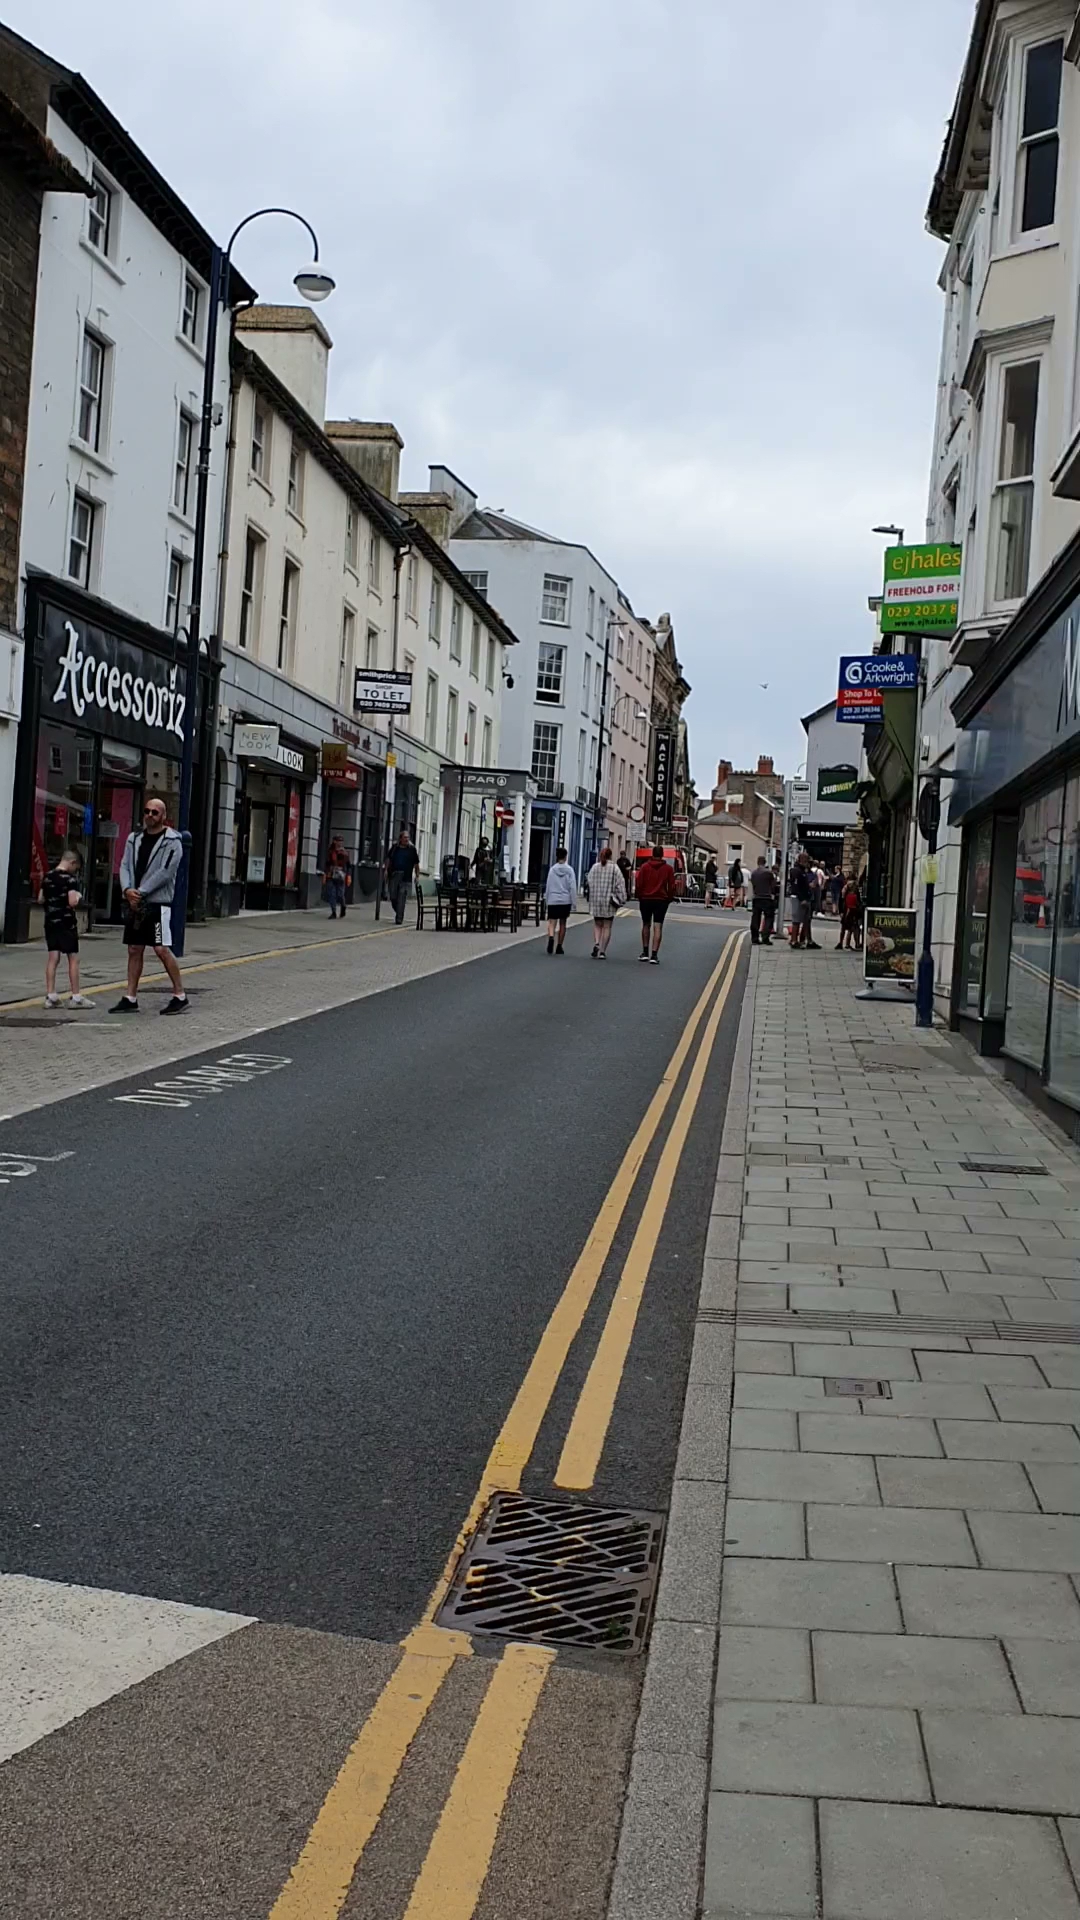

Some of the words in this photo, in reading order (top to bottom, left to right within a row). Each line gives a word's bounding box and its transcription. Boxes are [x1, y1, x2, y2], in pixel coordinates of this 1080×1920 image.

[887, 585, 934, 597] FREEHOLD
[936, 583, 954, 593] FOR
[887, 605, 911, 617] 029
[914, 603, 947, 616] 2037
[53, 621, 187, 742] Accessoriz
[359, 671, 397, 680] smithprice
[863, 672, 914, 684] Arkwright
[363, 689, 380, 699] TO
[383, 691, 404, 701] LET
[844, 690, 863, 699] Shop
[864, 689, 872, 697] To
[242, 732, 271, 741] NEW
[657, 733, 669, 741] The
[239, 741, 273, 751] LOOK
[282, 748, 303, 771] LOOK
[656, 743, 667, 812] ACADEMY
[821, 782, 855, 795] SUBWAY
[873, 917, 909, 929] FLAVOUR
[114, 1054, 293, 1108] DISABLED
